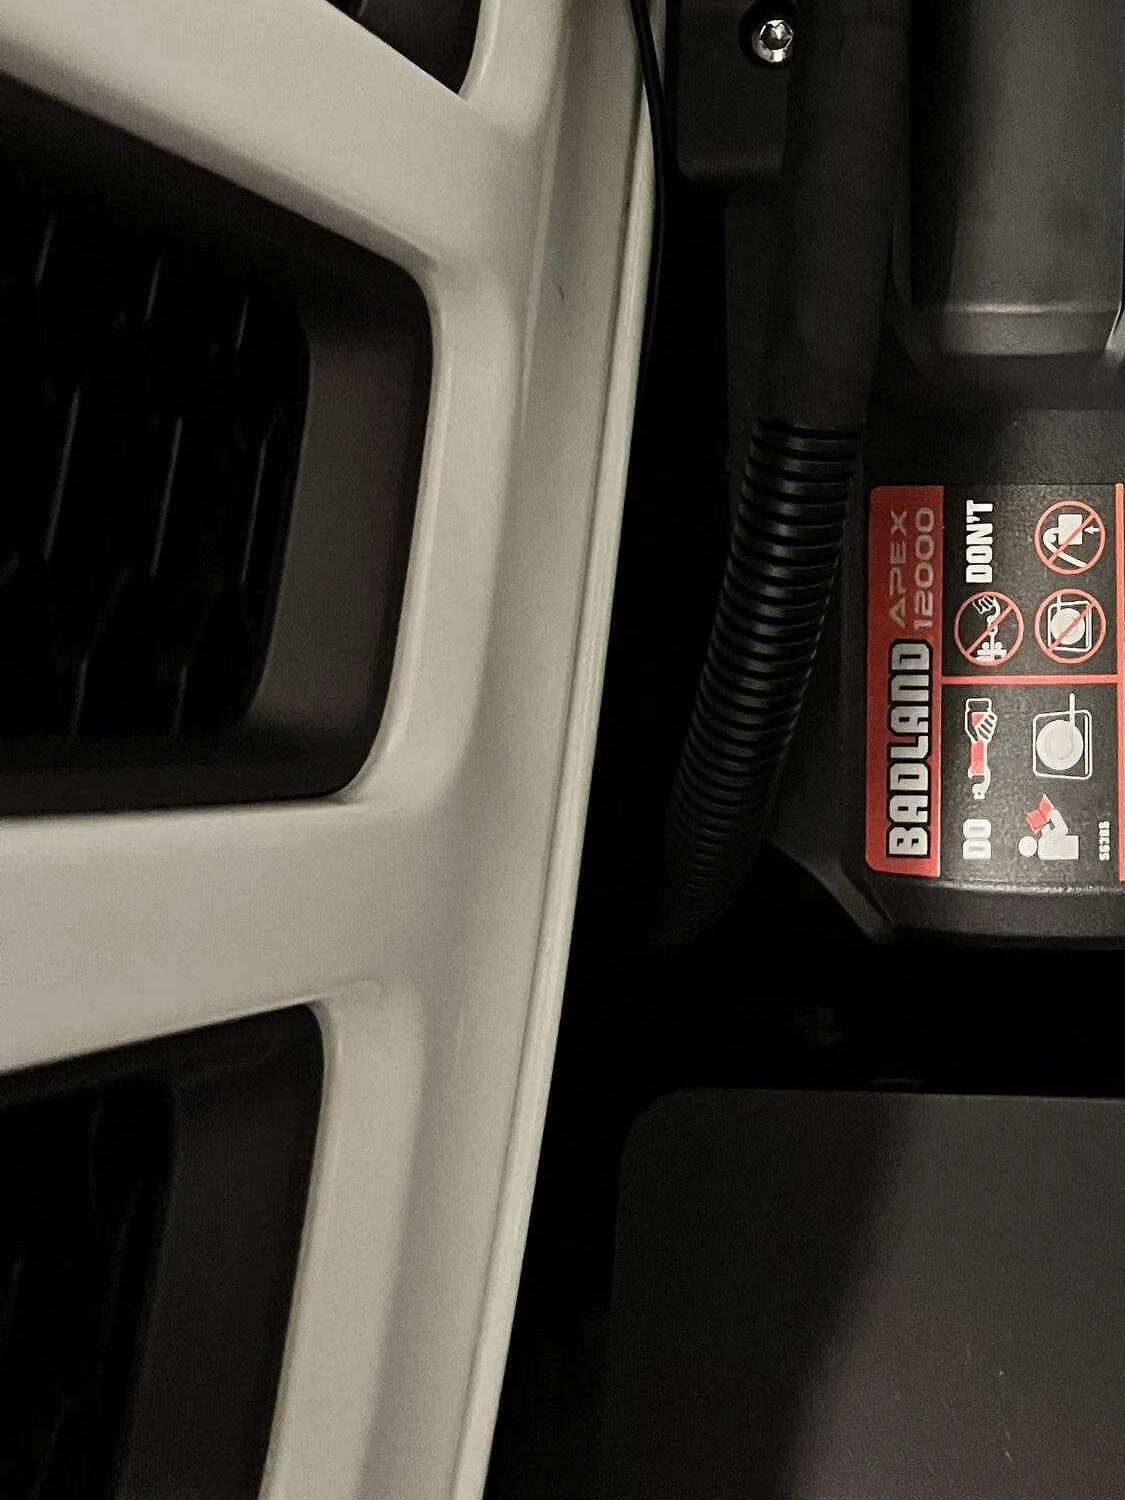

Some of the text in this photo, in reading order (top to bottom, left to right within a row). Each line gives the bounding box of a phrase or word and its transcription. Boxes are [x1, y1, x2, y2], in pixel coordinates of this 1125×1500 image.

[889, 510, 907, 629] APEX
[914, 508, 935, 630] 12000
[966, 500, 994, 583] DON'T
[887, 641, 931, 857] BADLAND
[963, 818, 991, 860] DO
